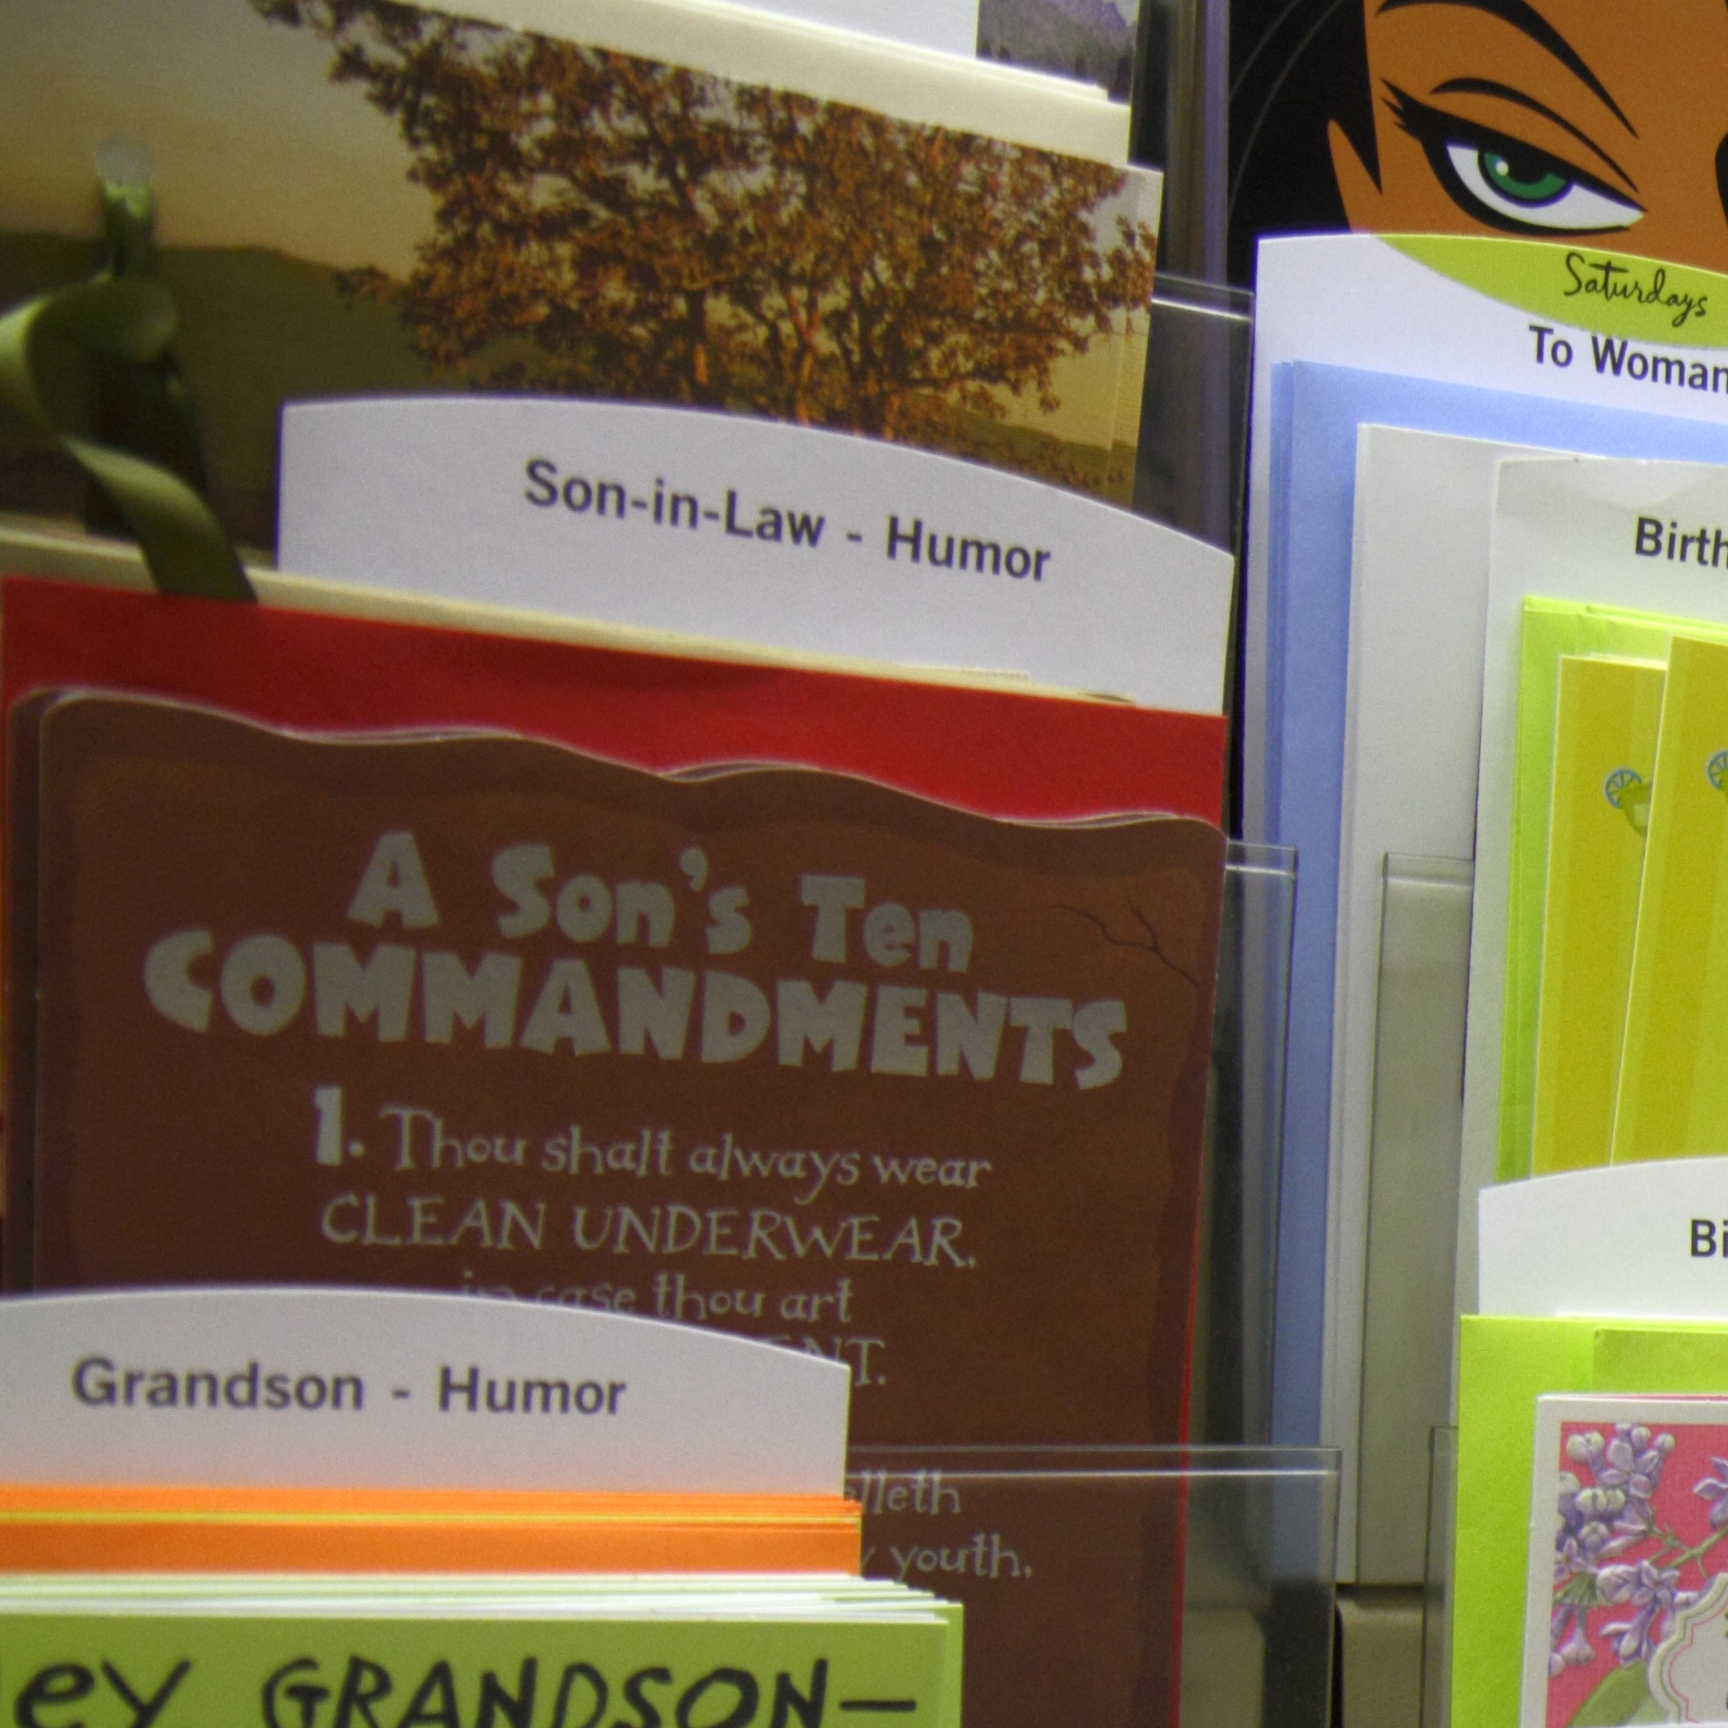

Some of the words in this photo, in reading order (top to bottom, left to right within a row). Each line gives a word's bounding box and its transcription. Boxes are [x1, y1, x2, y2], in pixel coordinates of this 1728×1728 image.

[1529, 325, 1572, 368] To
[522, 459, 825, 548] Son-in-Law
[886, 514, 1052, 584] Humor
[347, 831, 438, 928] A
[492, 847, 753, 950] Son's
[798, 874, 974, 973] Ten
[144, 930, 1128, 1090] COMMANDMENTS
[380, 1108, 528, 1172] Thou
[541, 1123, 674, 1176] shalt
[690, 1130, 859, 1205] always
[875, 1149, 991, 1190] wear
[321, 1196, 546, 1249] CLEAN
[572, 1205, 977, 1268] UNDERWEAR,
